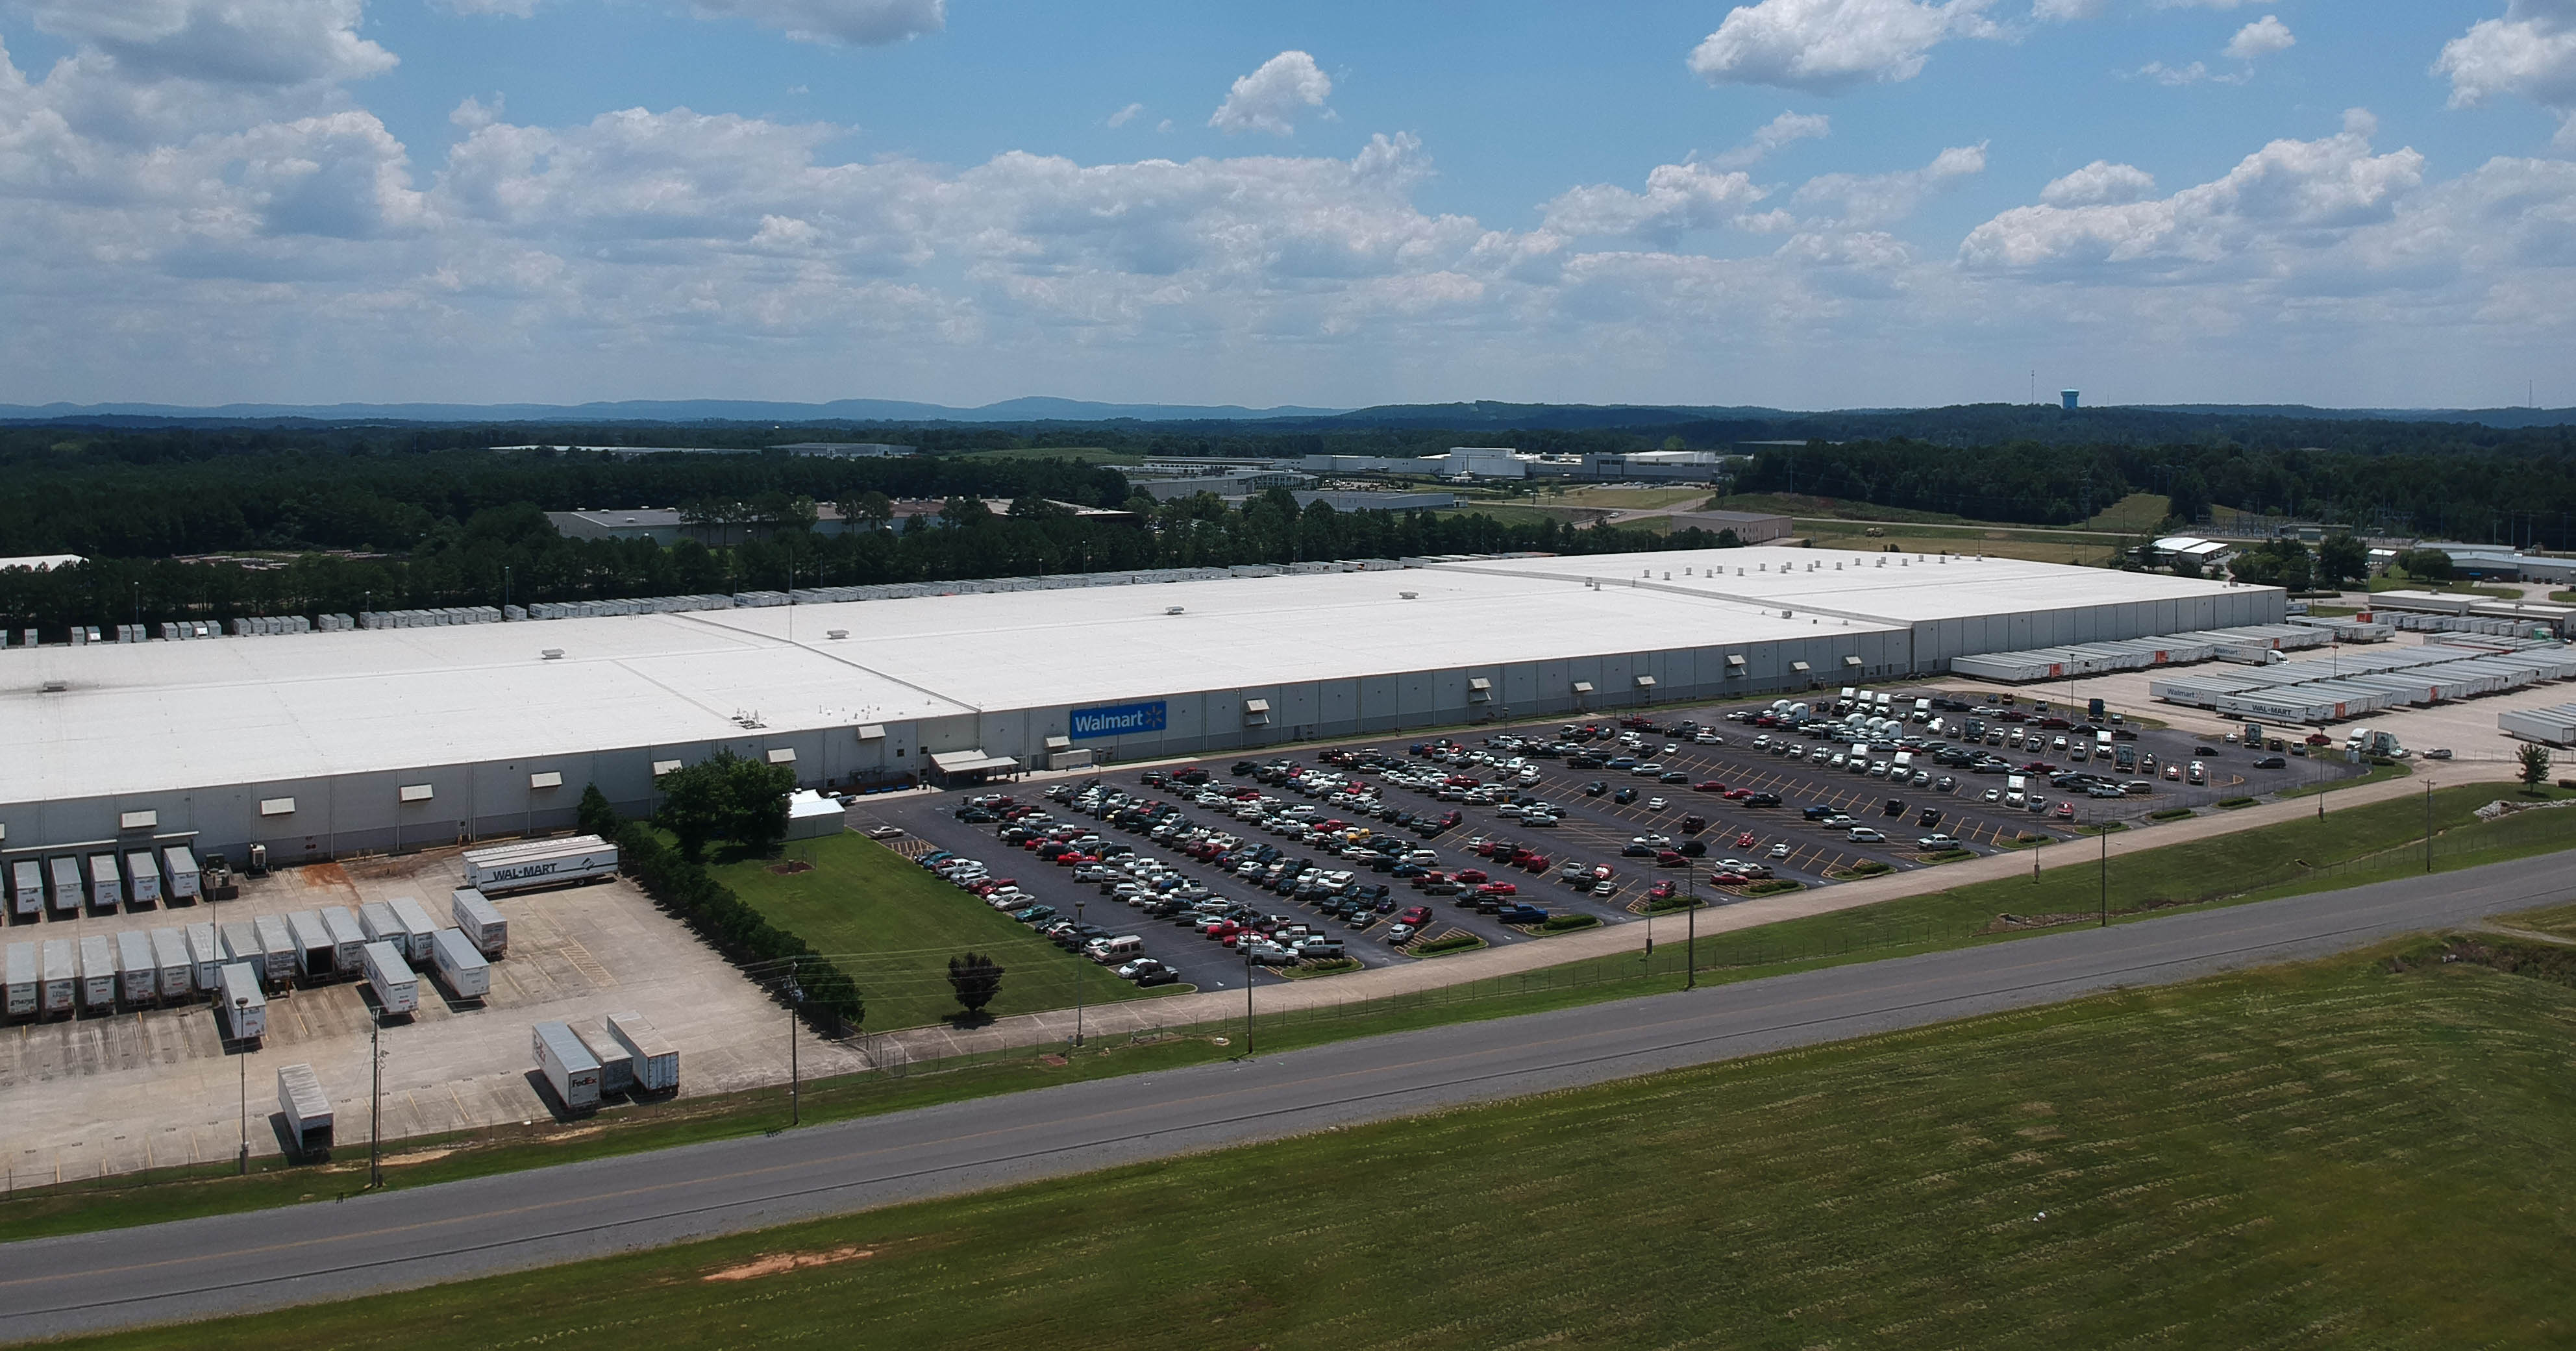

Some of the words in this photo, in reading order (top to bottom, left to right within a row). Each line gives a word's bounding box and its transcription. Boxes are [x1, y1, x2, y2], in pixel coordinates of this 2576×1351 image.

[2167, 688, 2195, 698] Walmart
[1075, 710, 1143, 732] Walmart
[572, 1076, 597, 1088] FedEx
